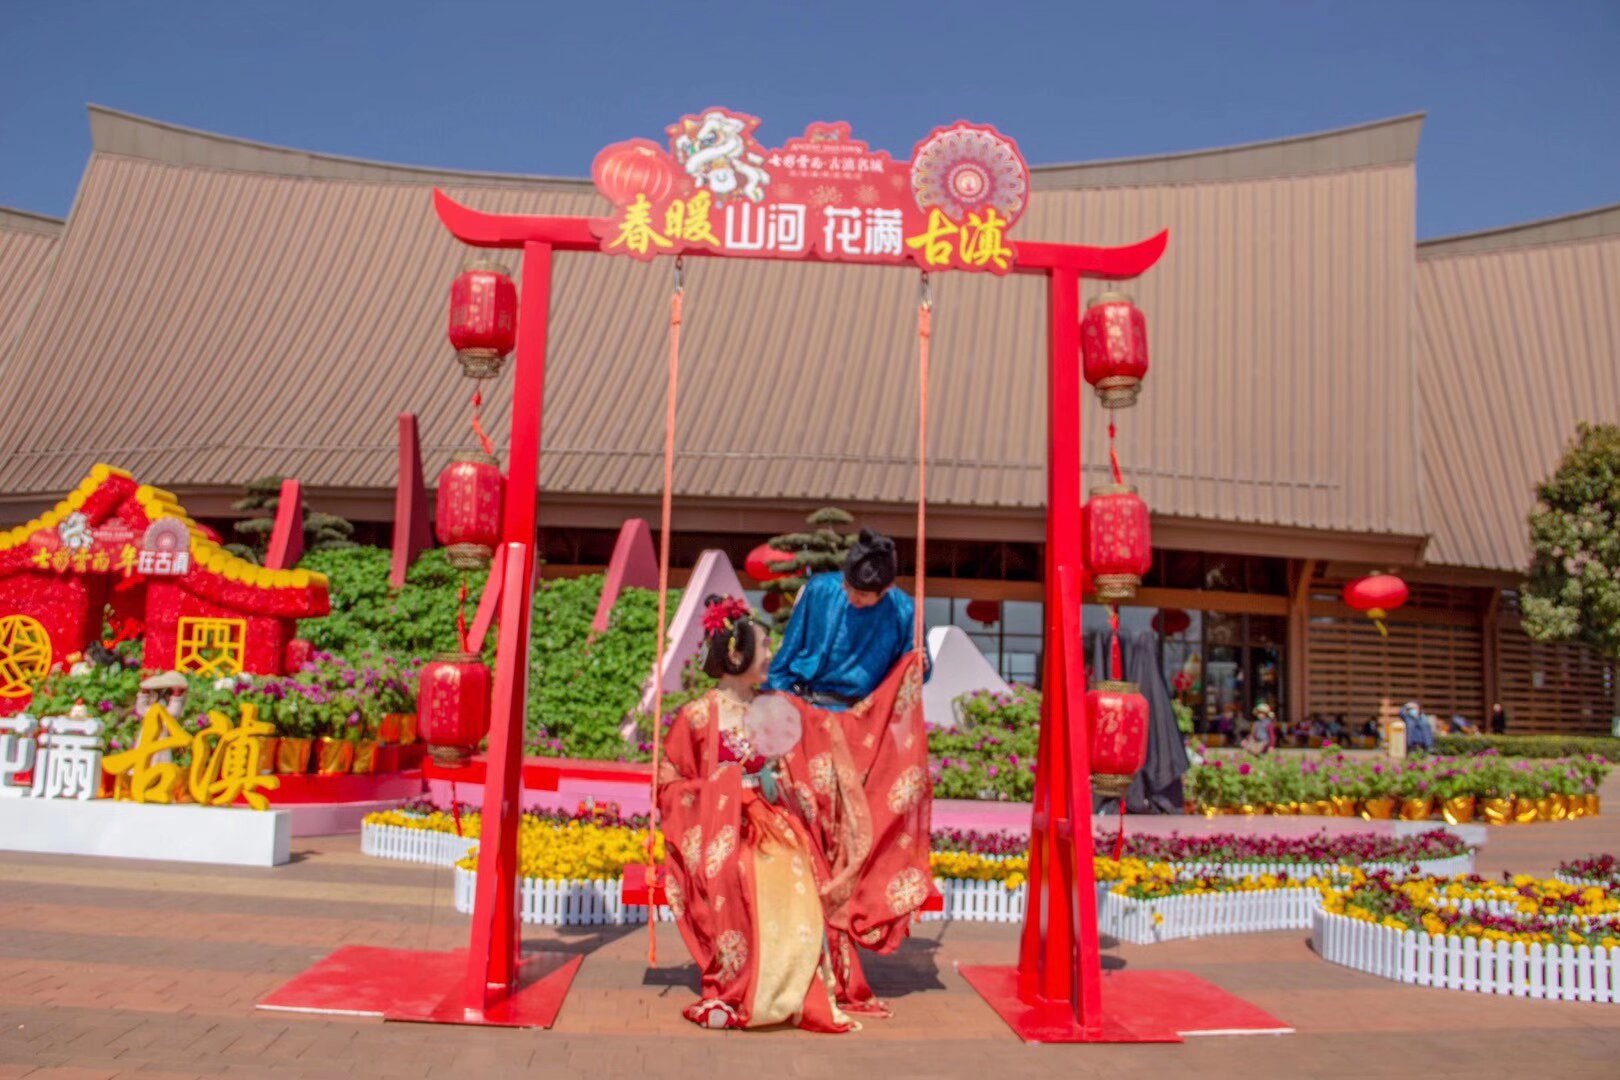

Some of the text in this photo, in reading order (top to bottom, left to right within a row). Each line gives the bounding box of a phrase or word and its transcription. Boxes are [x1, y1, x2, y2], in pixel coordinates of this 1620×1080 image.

[608, 189, 1013, 270] 春暖山河 花满古滇
